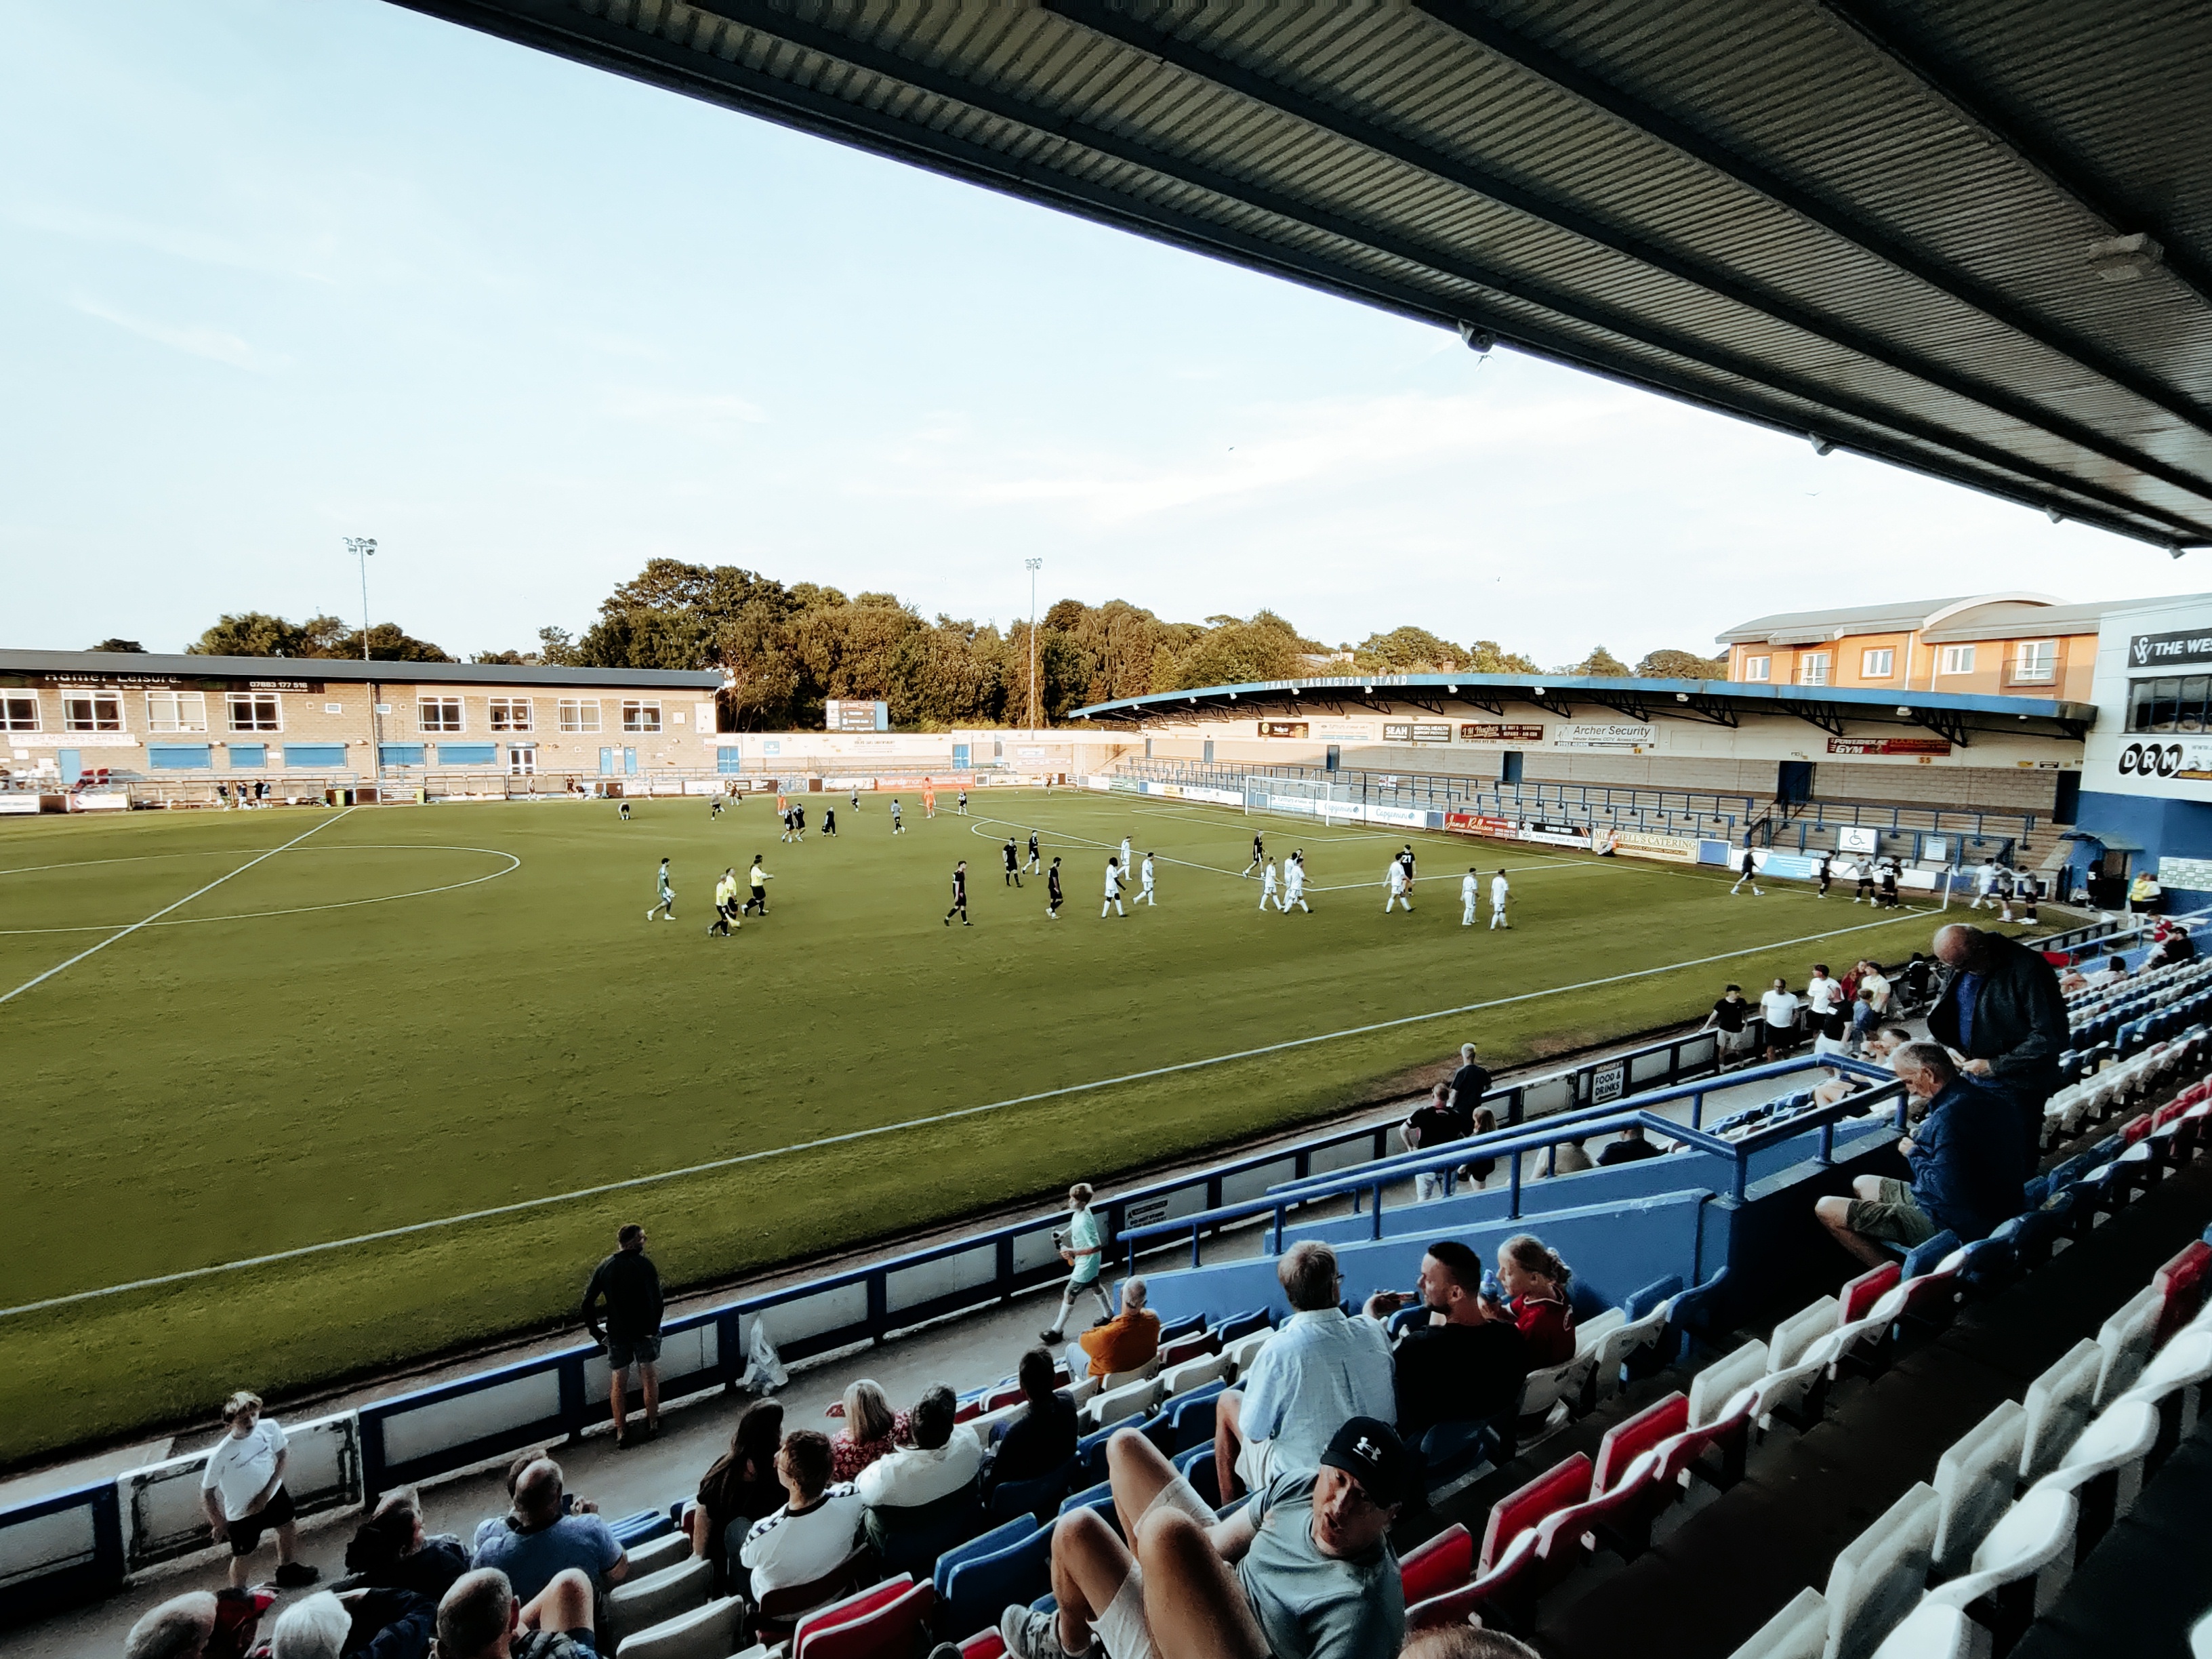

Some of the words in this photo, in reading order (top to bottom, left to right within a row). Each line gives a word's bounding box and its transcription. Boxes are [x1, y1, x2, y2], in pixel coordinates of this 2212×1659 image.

[2154, 640, 2184, 656] THE
[1265, 679, 1294, 690] FRANK
[1302, 676, 1361, 687] NAGINGTON
[1370, 675, 1408, 686] STAND
[1385, 725, 1408, 735] SEAH
[1475, 725, 1499, 737] Hughes
[1573, 726, 1606, 735] Archer
[1608, 726, 1650, 737] Security
[1836, 745, 1864, 754] GYM
[1376, 808, 1408, 821] Capgemini
[1446, 815, 1465, 830] James
[1647, 838, 1696, 849] CATERING
[1402, 855, 1412, 863] 21
[1595, 1073, 1615, 1086] FOOD
[1616, 1070, 1621, 1079] &
[1595, 1081, 1620, 1096] DRINKS
